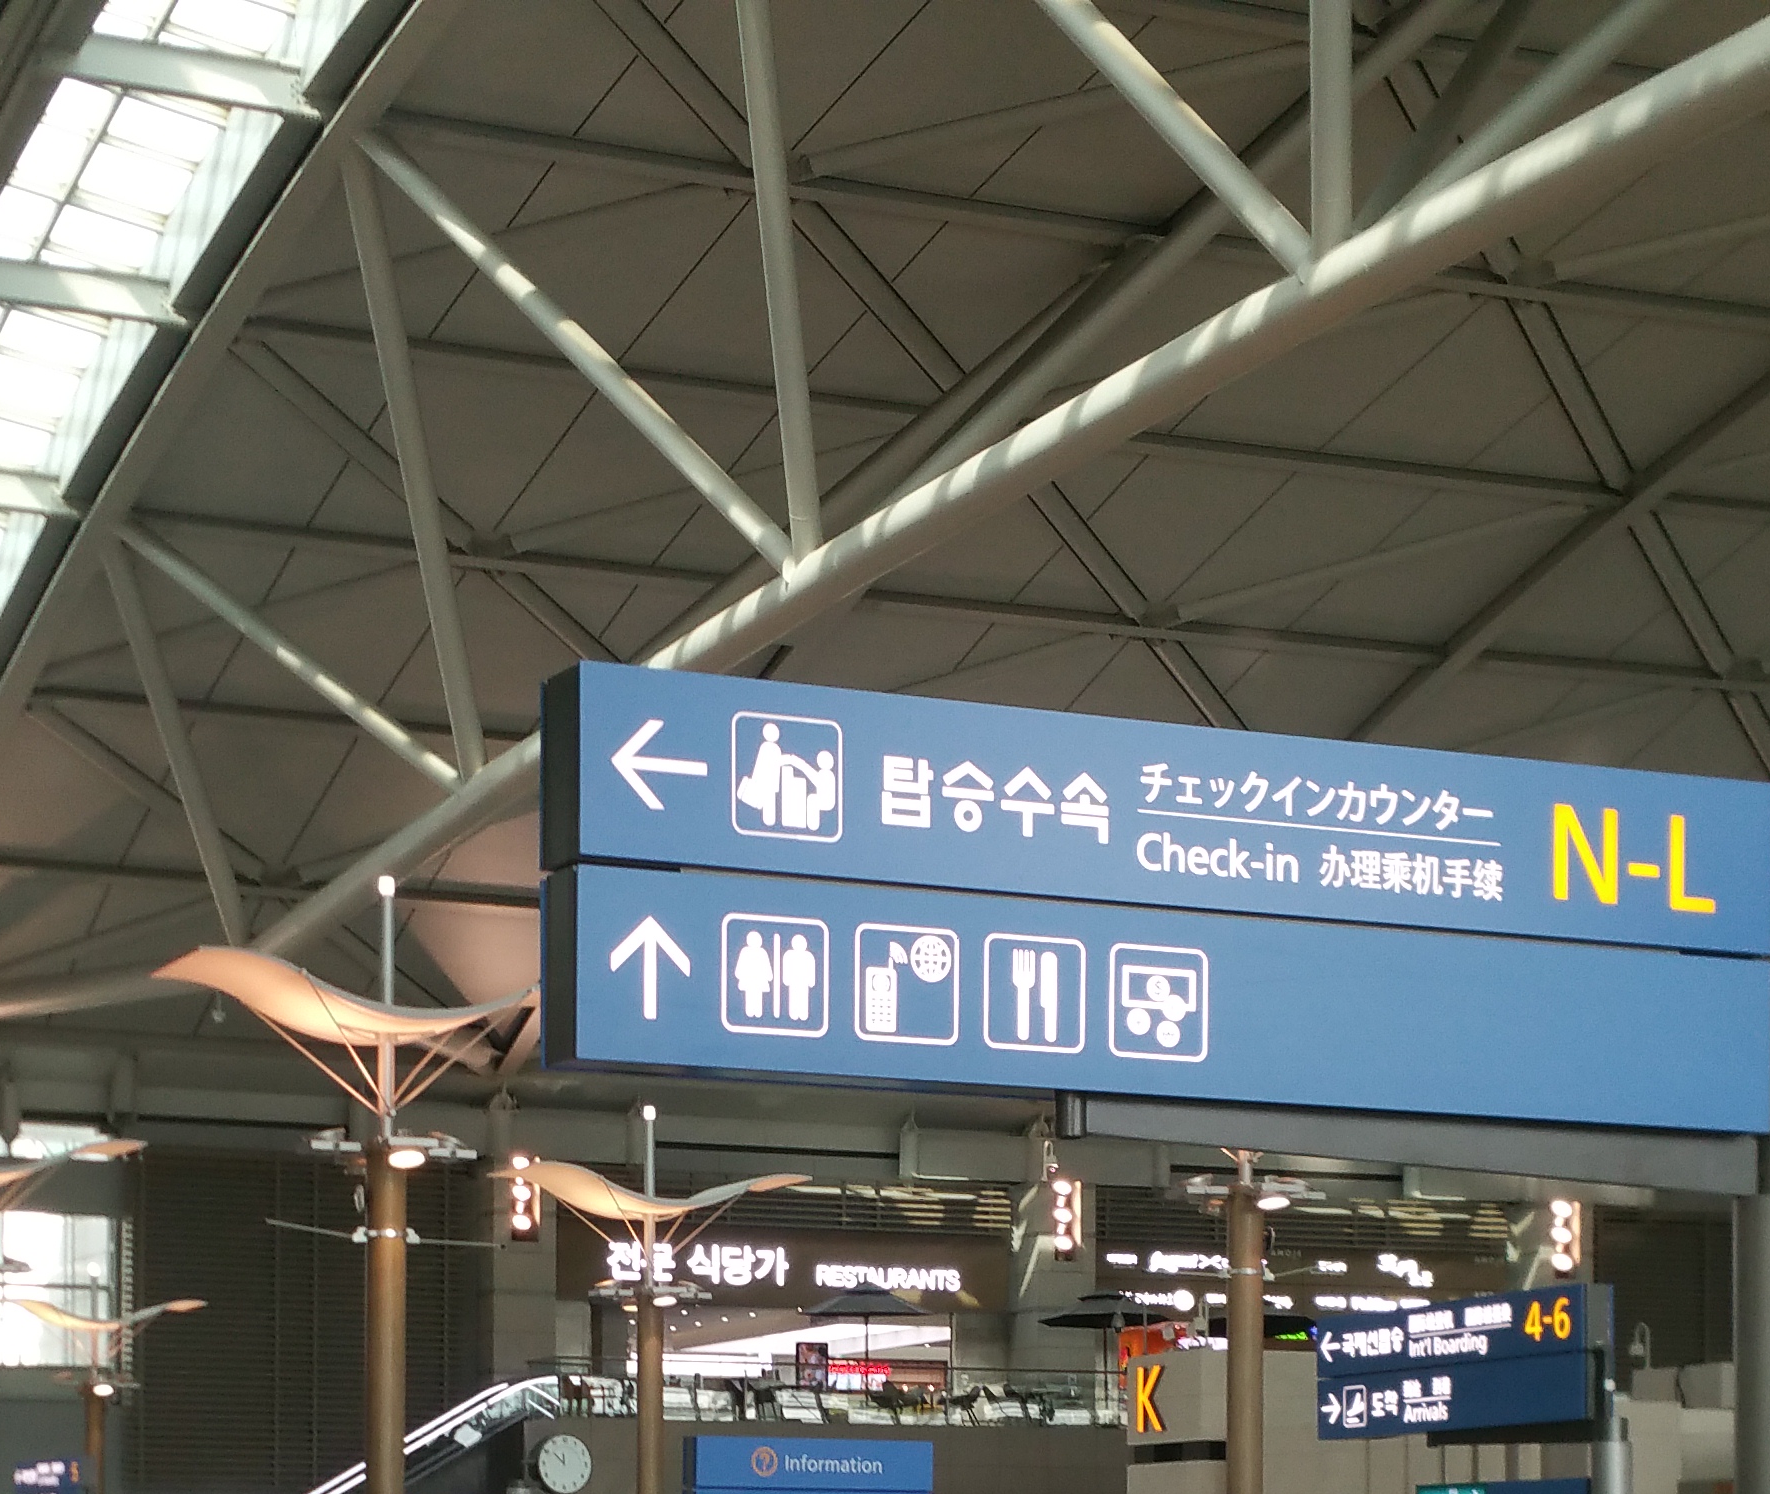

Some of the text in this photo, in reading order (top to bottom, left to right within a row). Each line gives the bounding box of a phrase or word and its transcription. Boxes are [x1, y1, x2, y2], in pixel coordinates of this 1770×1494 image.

[881, 755, 1109, 844] 탑승수속
[1139, 762, 1494, 832] チェックインカウンター
[1136, 832, 1300, 884] Check-in
[1318, 844, 1504, 901] 办理乘机手续
[1552, 803, 1717, 914] N-L
[686, 1243, 789, 1287] 식당가
[815, 1264, 962, 1292] RESTAURANTS
[1523, 1296, 1572, 1342] 4-6
[1433, 1332, 1489, 1356] Boarding
[1135, 1364, 1164, 1433] K
[1403, 1402, 1450, 1424] Arrivals
[784, 1453, 884, 1475] Information
